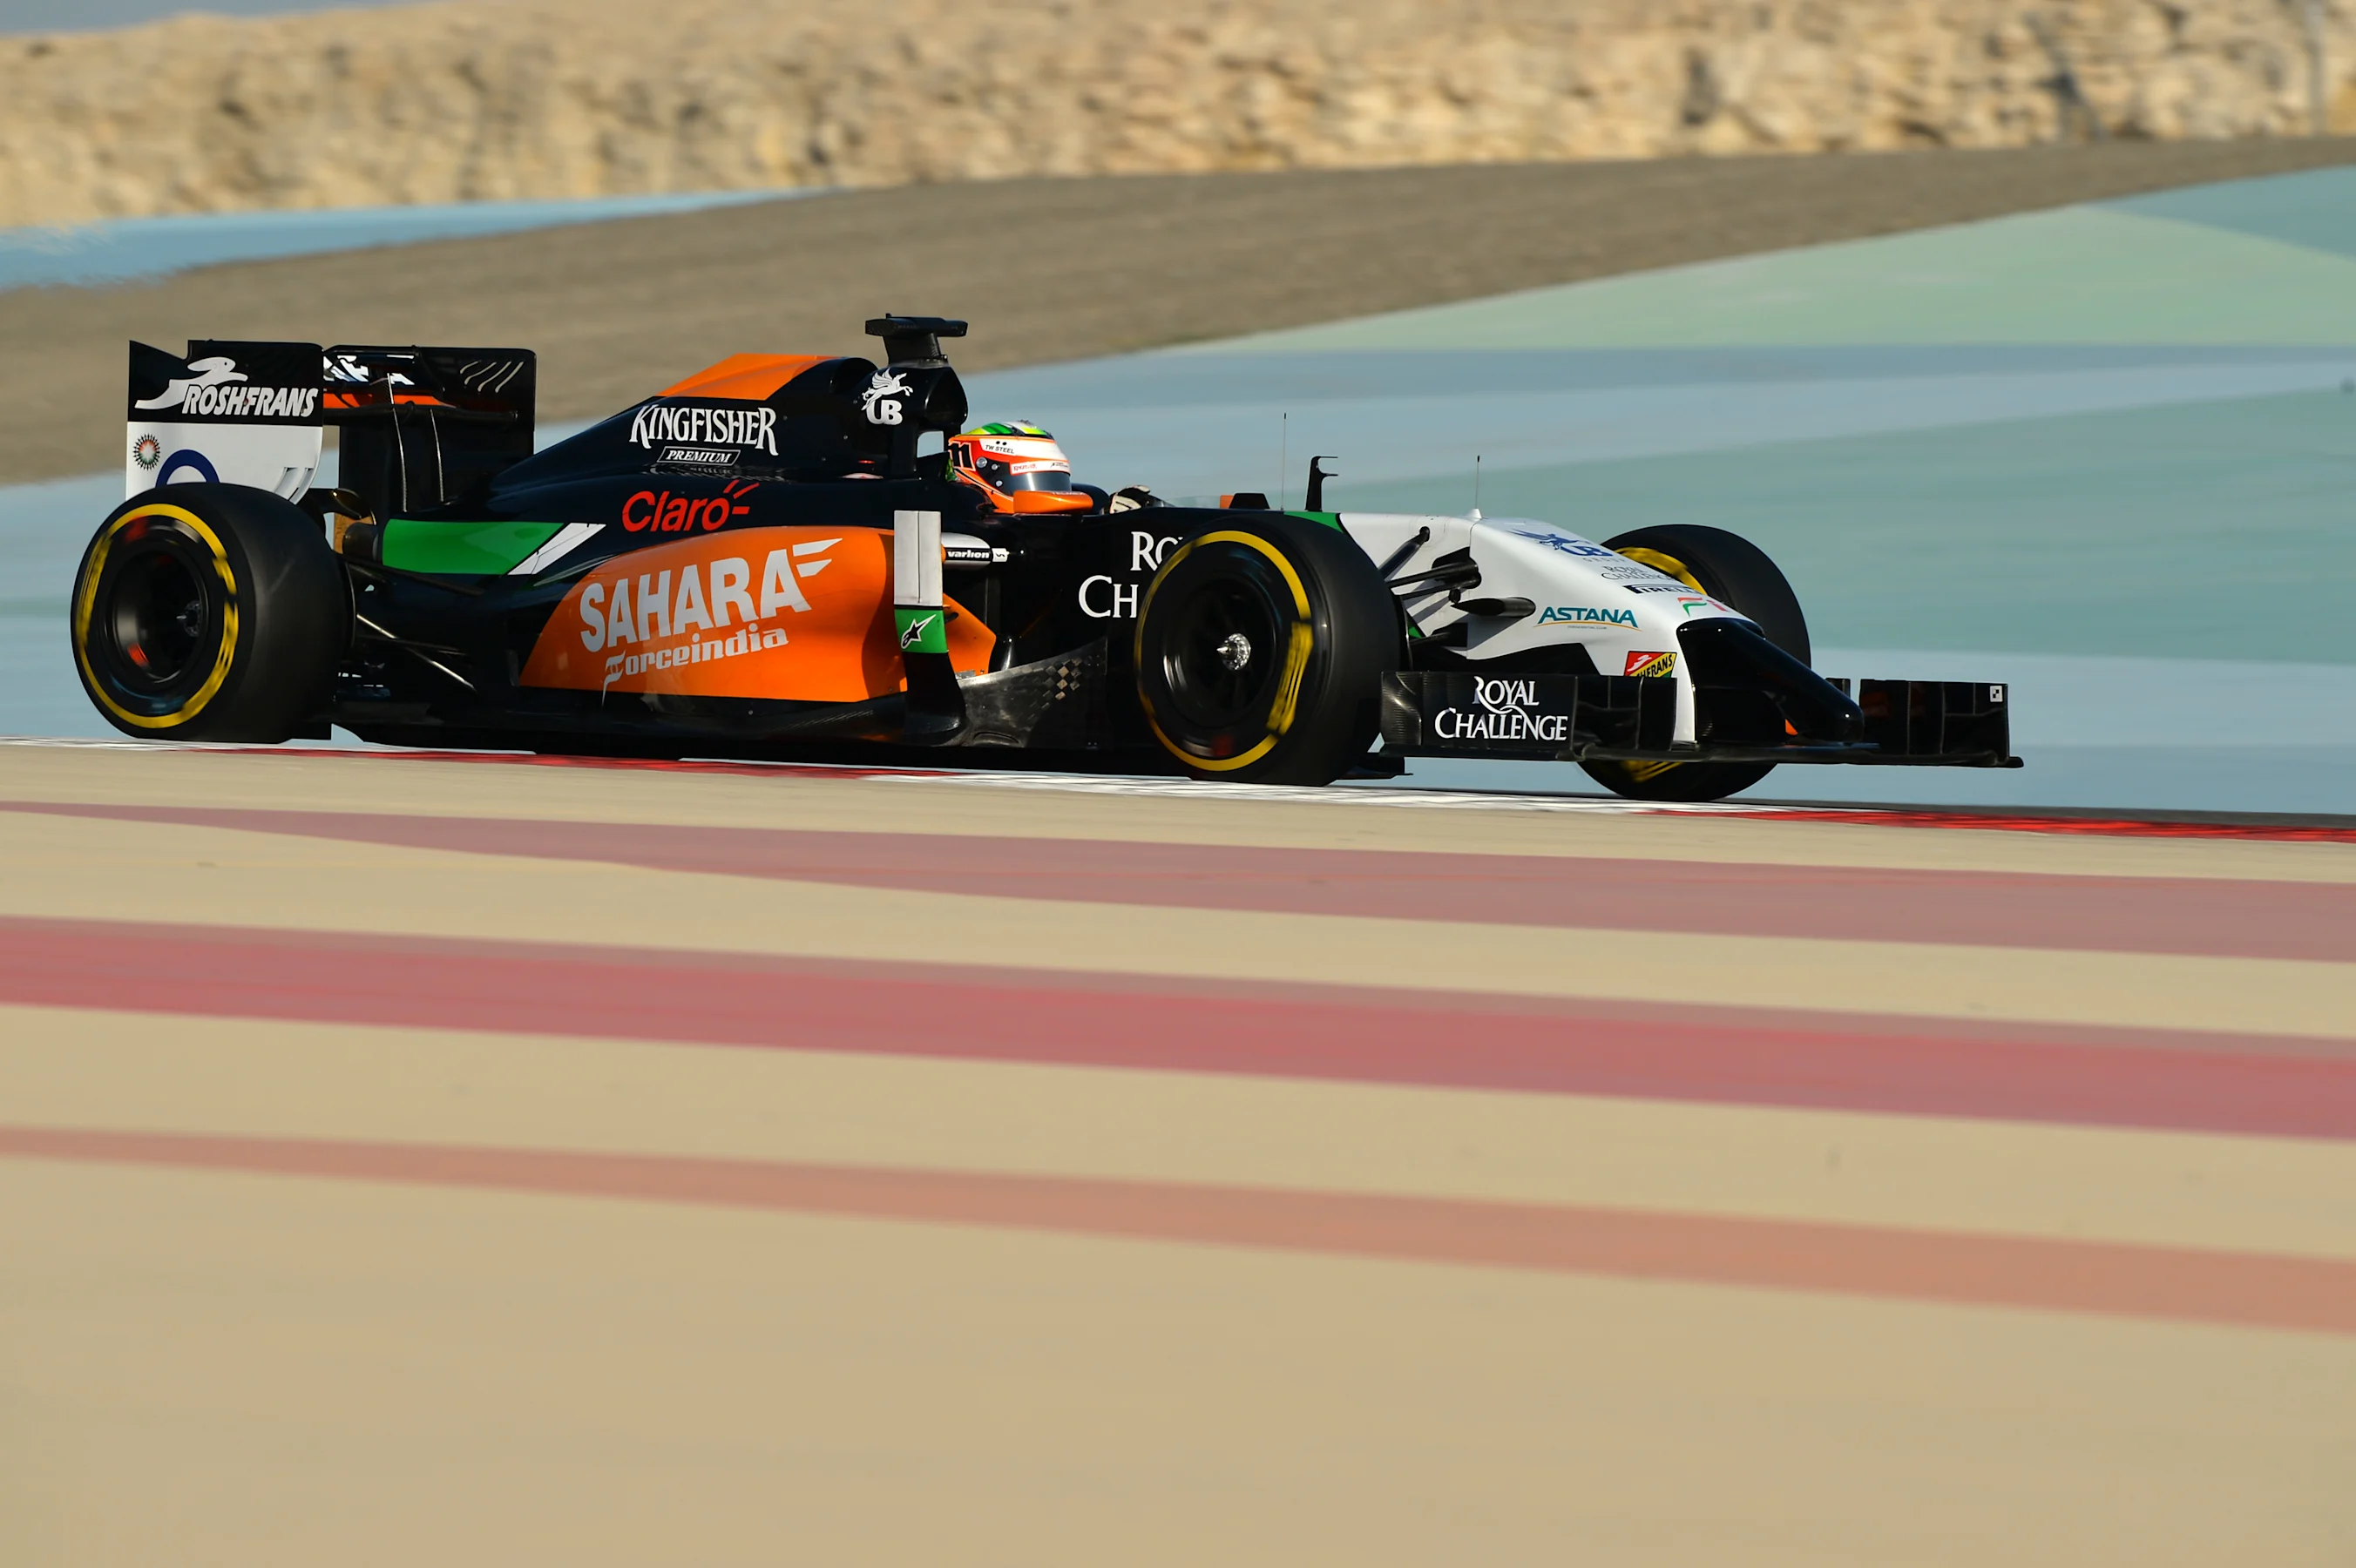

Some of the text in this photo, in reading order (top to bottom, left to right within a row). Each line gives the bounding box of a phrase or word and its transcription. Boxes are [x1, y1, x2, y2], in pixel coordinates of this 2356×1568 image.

[181, 385, 319, 417] ROSHFRANS
[865, 399, 903, 425] UB
[628, 404, 779, 456] KINGFISHER
[666, 449, 732, 463] PREMIUM
[995, 445, 1015, 455] STEEL
[621, 490, 731, 533] Claro
[947, 549, 991, 559] varlion
[579, 548, 812, 652] SAHARA
[1537, 606, 1639, 628] ASTANA
[1472, 675, 1540, 714] ROYAL
[1434, 705, 1568, 740] CHALLENGE
